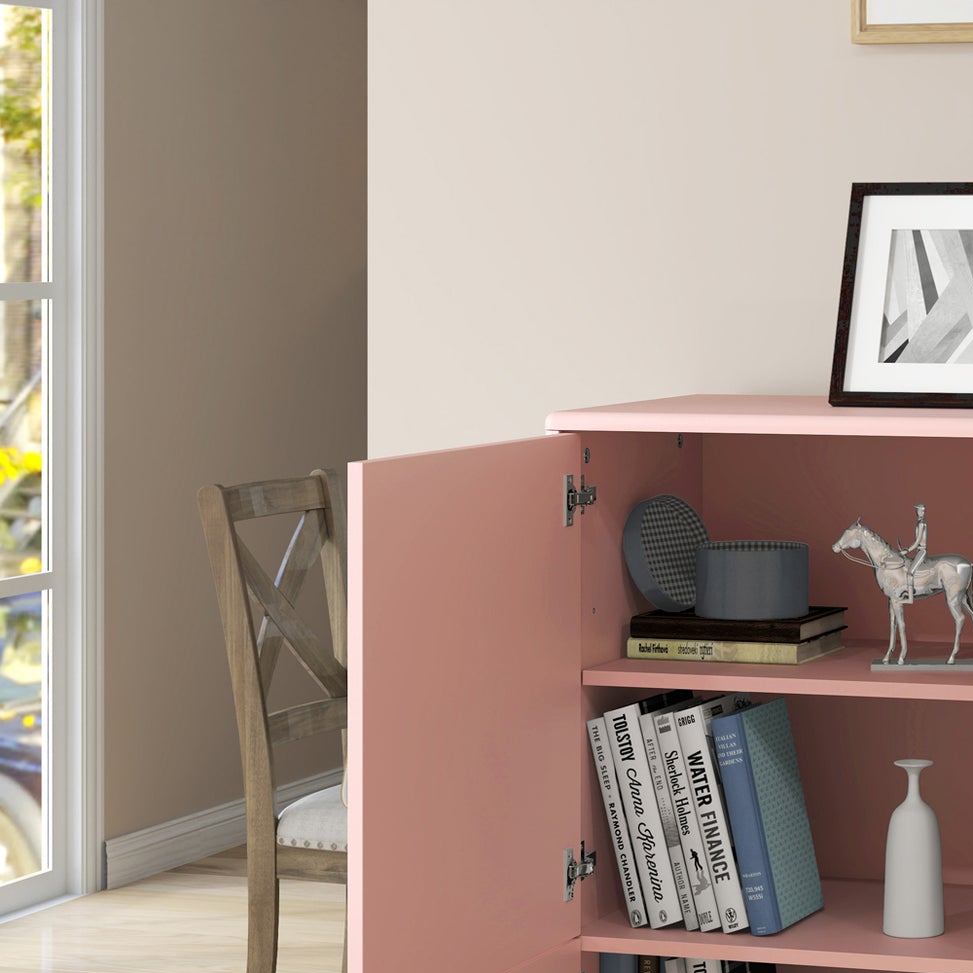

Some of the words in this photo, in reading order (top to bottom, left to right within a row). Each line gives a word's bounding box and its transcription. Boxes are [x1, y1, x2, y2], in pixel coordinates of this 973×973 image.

[677, 714, 696, 727] GRIGG
[646, 738, 656, 762] AFTER
[654, 775, 664, 791] END
[664, 750, 686, 797] Sherlock
[675, 797, 691, 836] Holmes
[591, 725, 600, 741] THE
[600, 765, 612, 790] SLEEP
[608, 802, 624, 850] RAYMOND
[620, 853, 637, 903] CHANDLER
[612, 713, 636, 762] TOLSTOY
[626, 768, 645, 817] Anna
[637, 822, 664, 903] Karenina
[687, 750, 713, 807] WATER
[701, 809, 731, 884] FINANCE
[673, 862, 686, 891] AUTHOR
[680, 893, 691, 914] NAME
